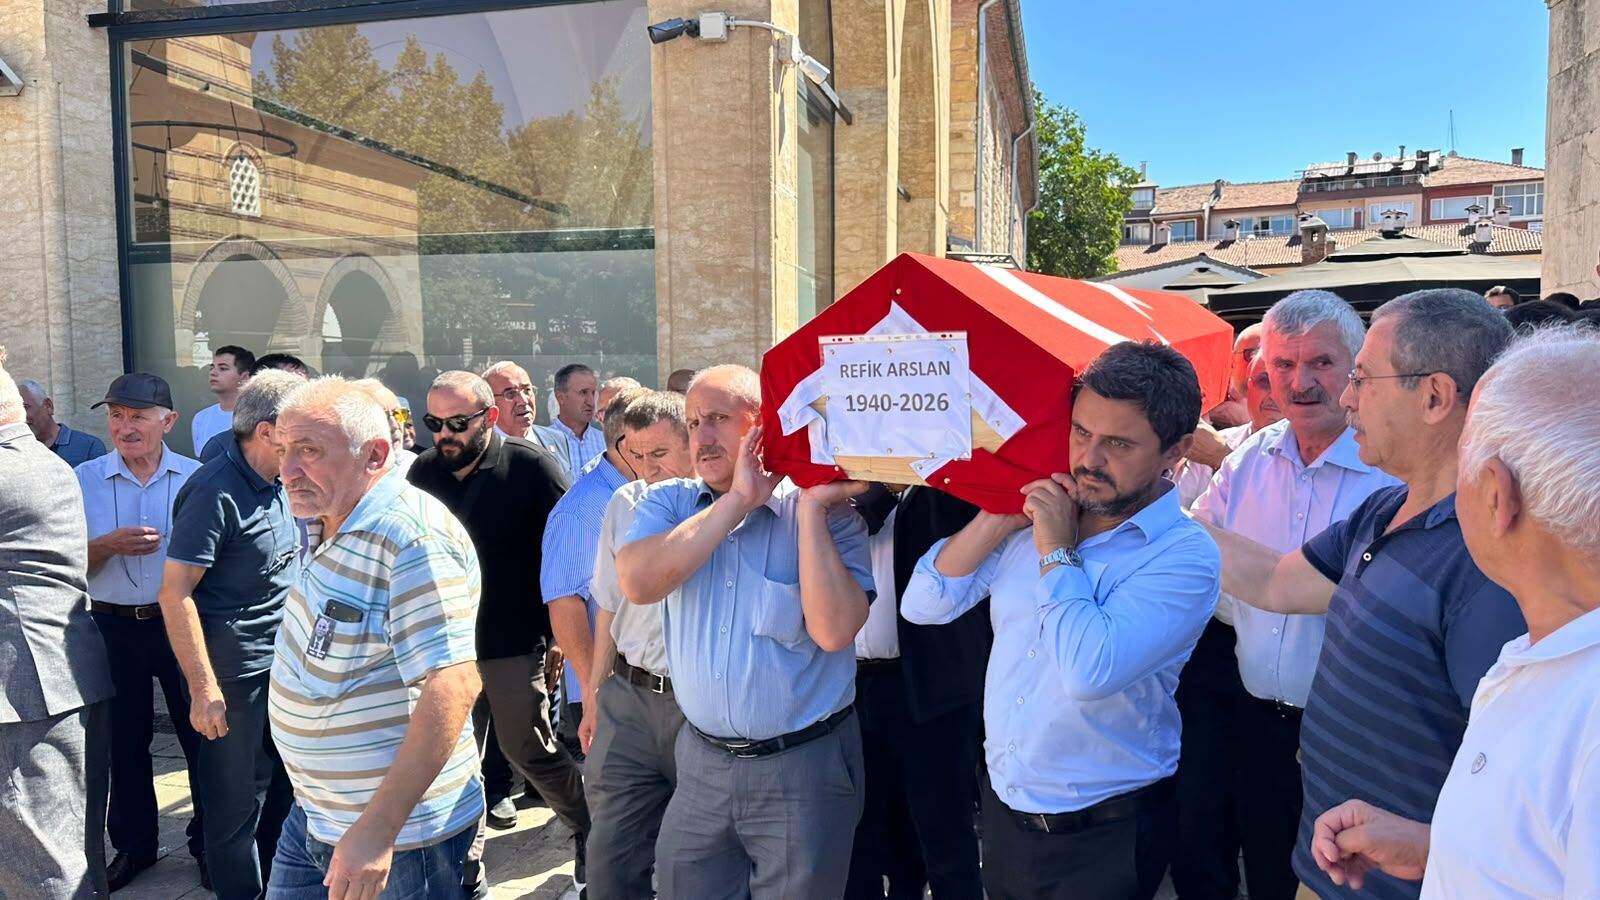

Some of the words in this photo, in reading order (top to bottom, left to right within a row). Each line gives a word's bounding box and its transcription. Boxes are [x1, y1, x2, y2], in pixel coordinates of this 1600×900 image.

[840, 360, 882, 378] REFİK
[887, 361, 951, 377] ARSLAN
[845, 393, 949, 412] 1940-2026
